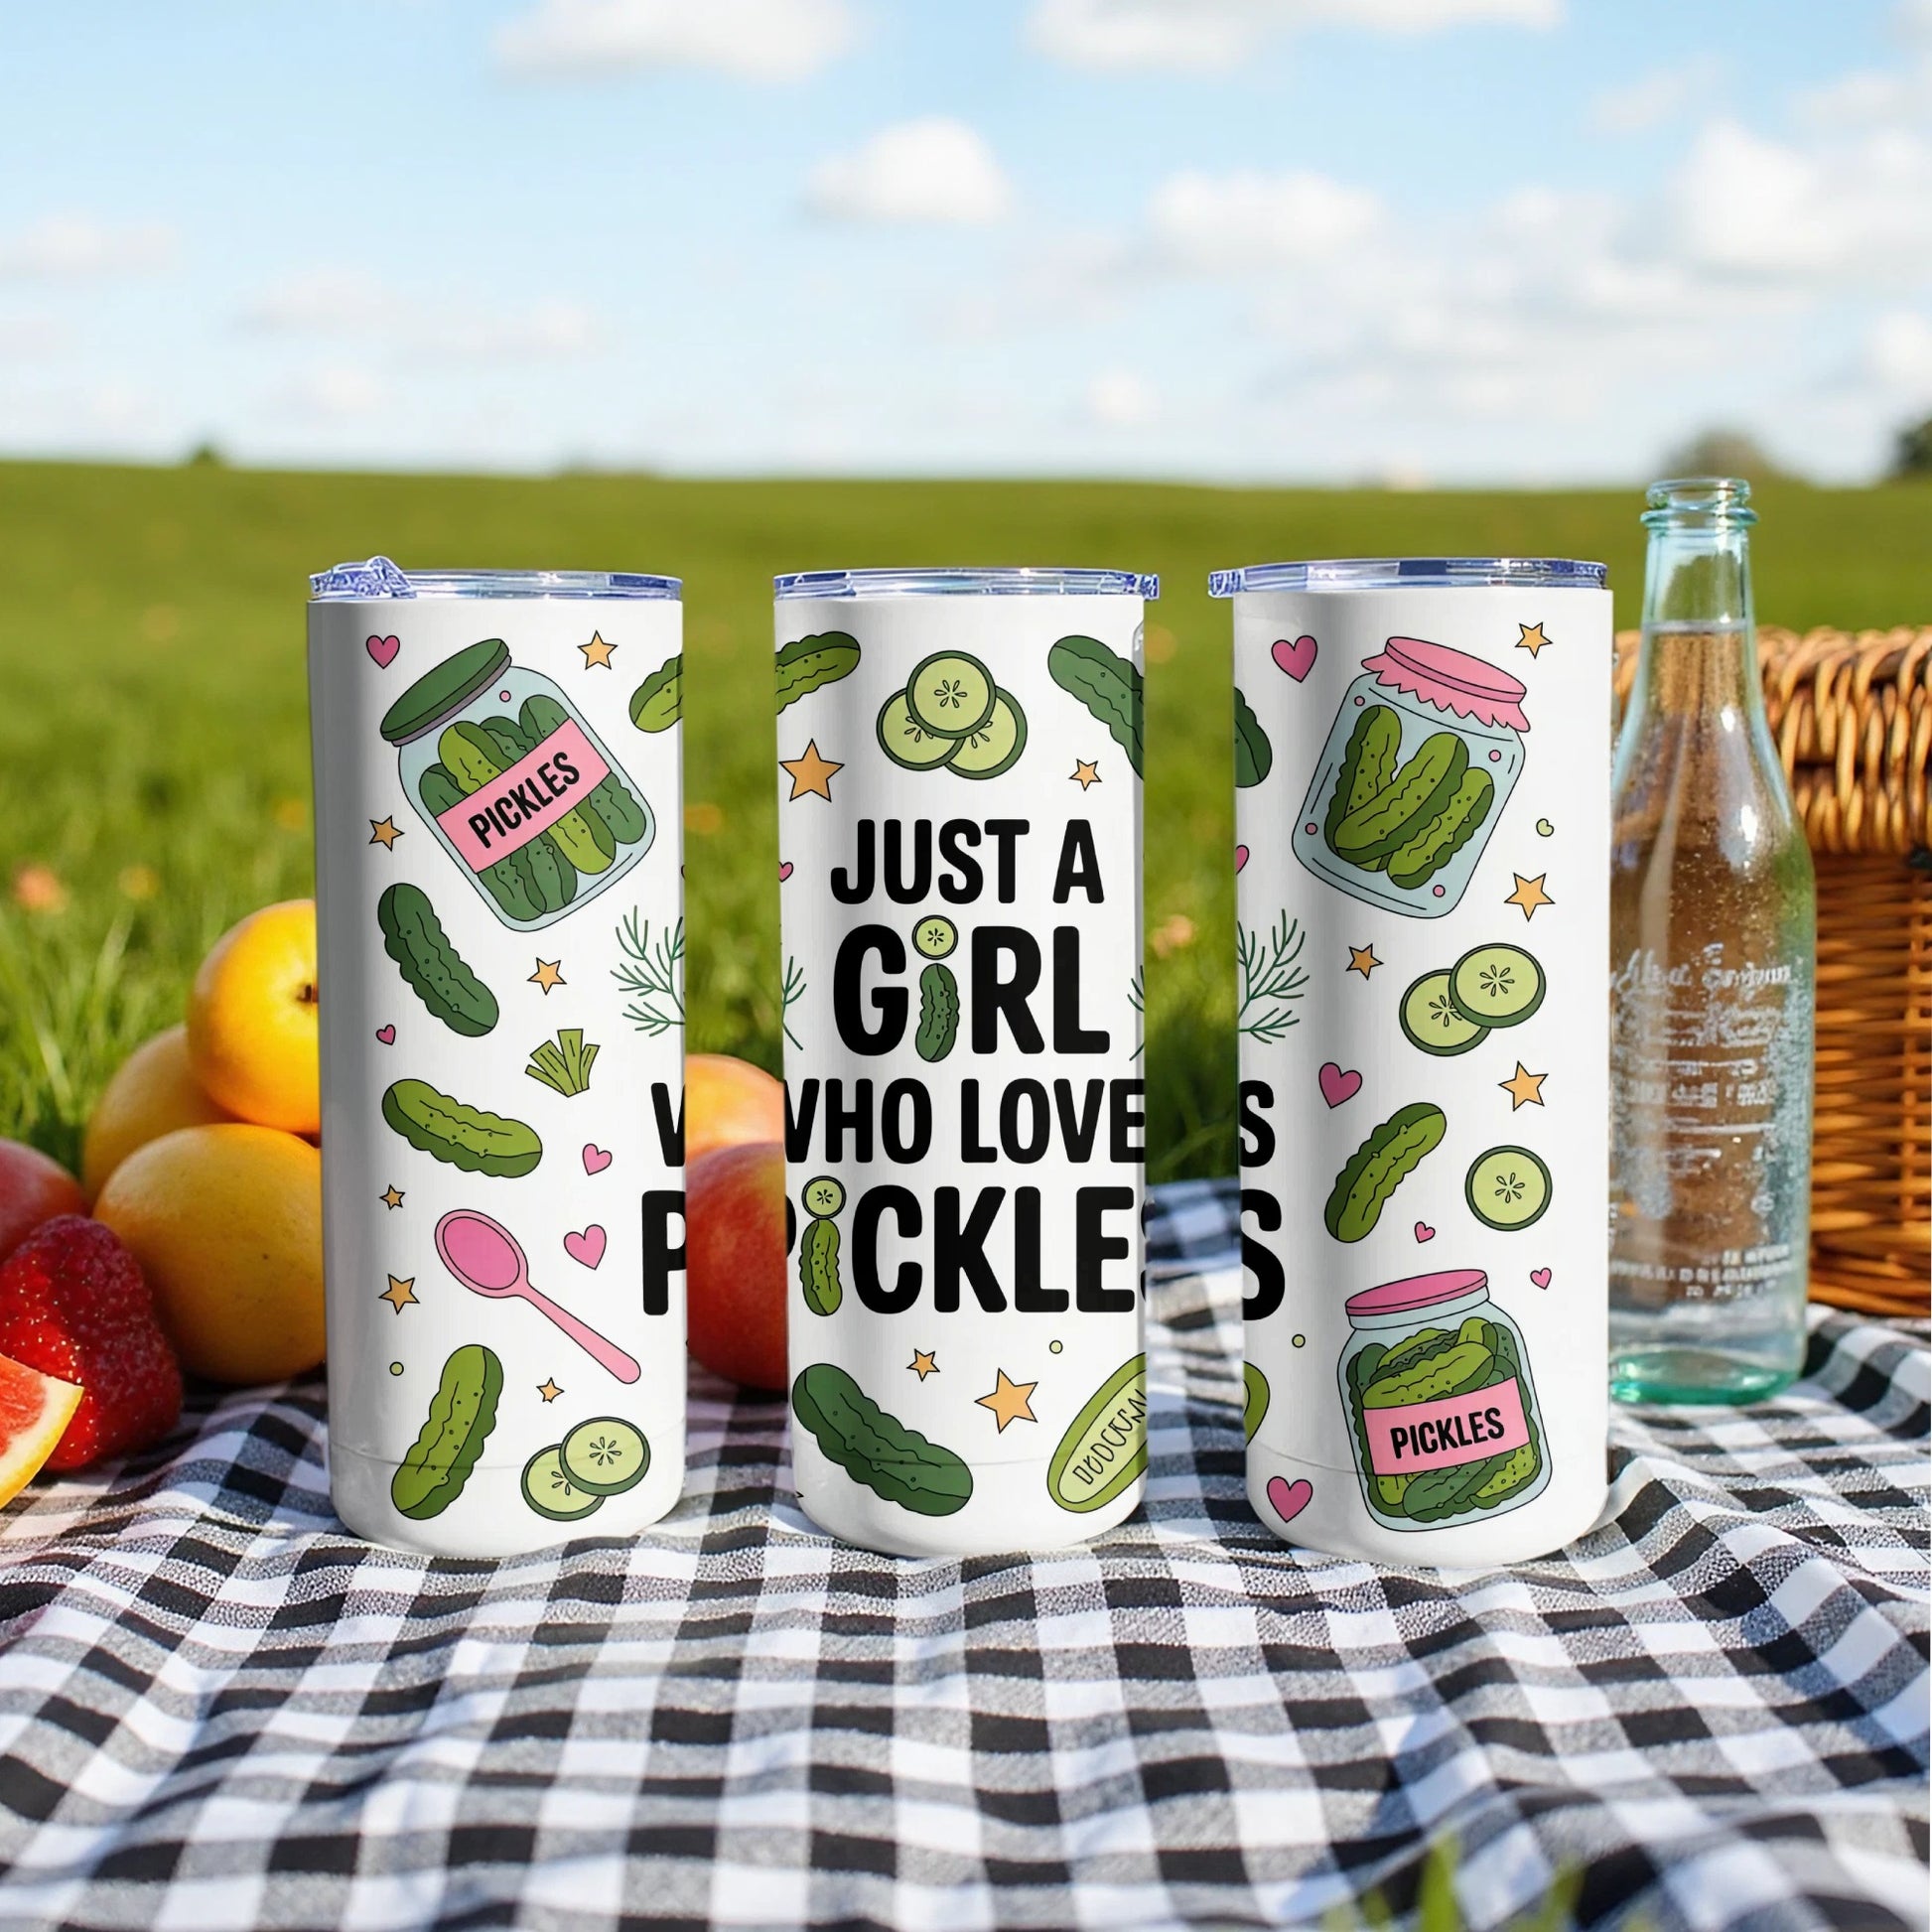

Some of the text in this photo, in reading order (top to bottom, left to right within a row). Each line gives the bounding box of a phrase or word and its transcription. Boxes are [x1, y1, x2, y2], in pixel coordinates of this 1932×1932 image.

[468, 752, 580, 849] PICKLES
[830, 819, 1105, 904] JUST A
[1390, 1407, 1505, 1459] PICKLES
